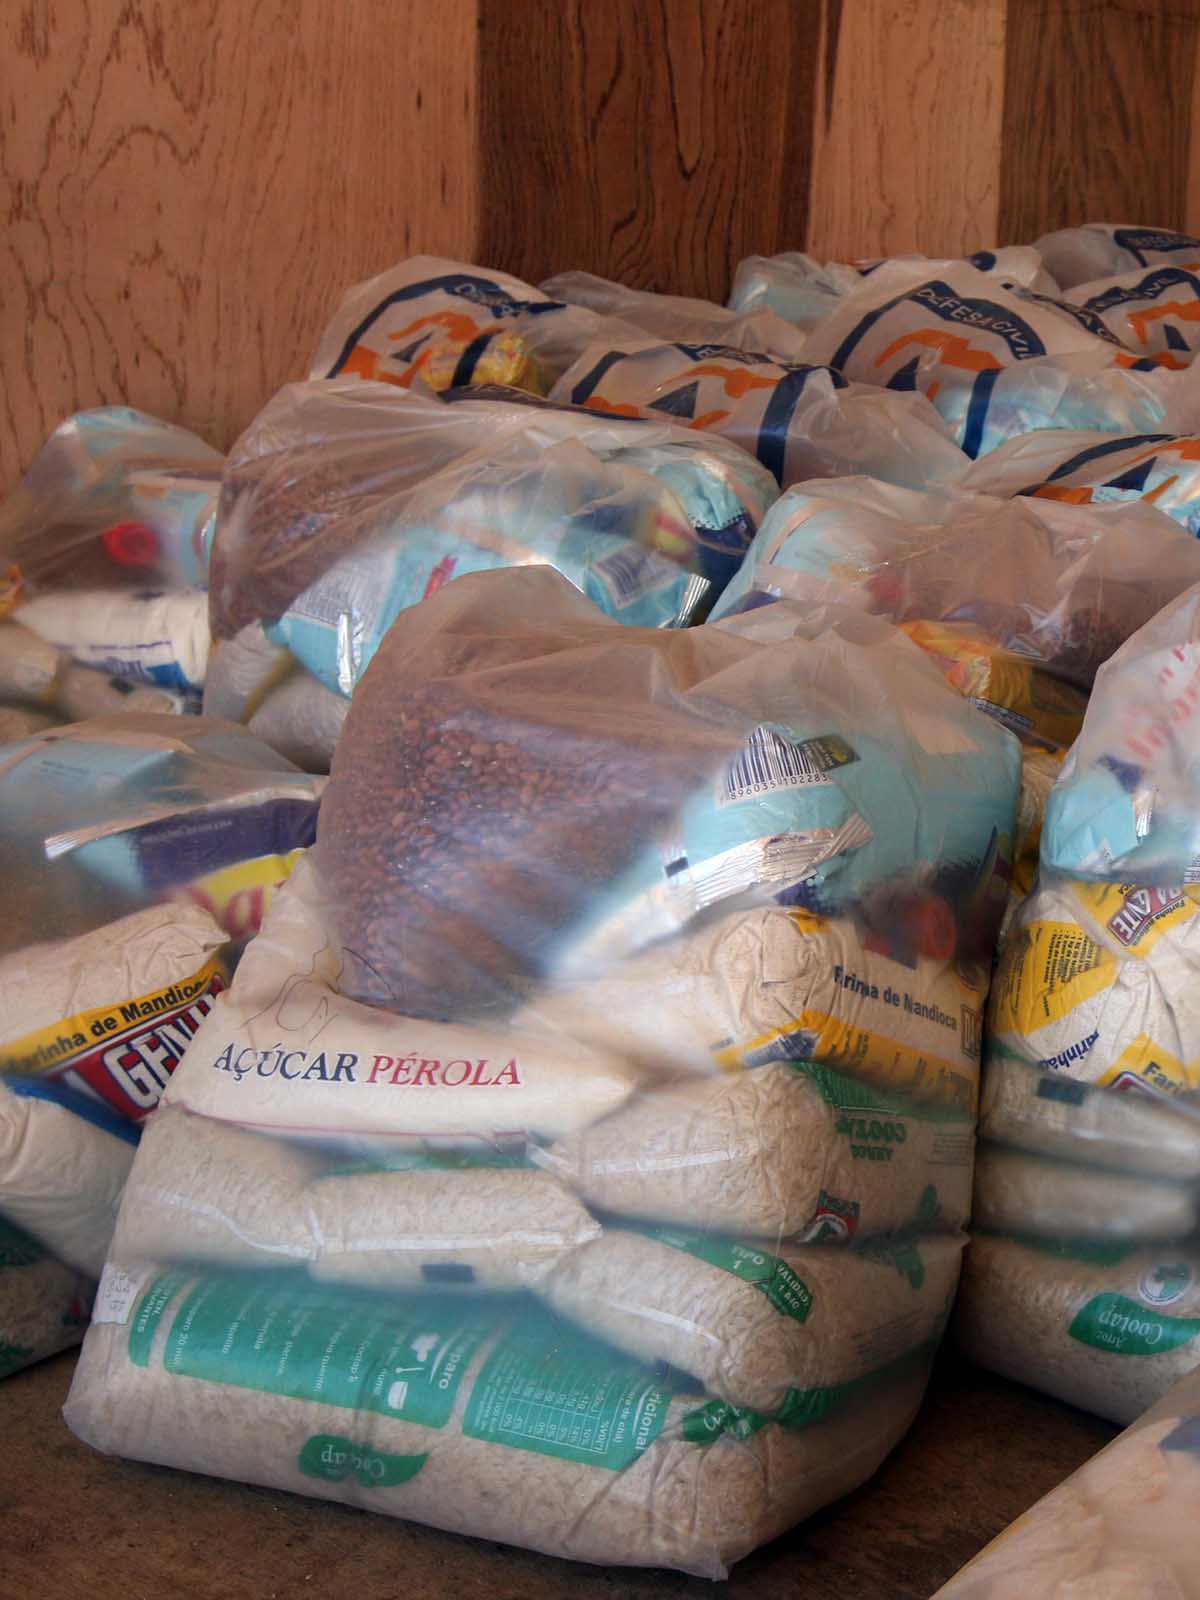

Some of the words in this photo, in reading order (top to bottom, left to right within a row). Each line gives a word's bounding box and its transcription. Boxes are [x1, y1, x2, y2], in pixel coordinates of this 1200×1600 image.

[883, 985, 901, 1007] de
[90, 1016, 118, 1037] de
[213, 1042, 359, 1082] AÇÚCAR
[366, 1052, 521, 1087] PÉROLA
[1098, 1304, 1163, 1345] Cootap
